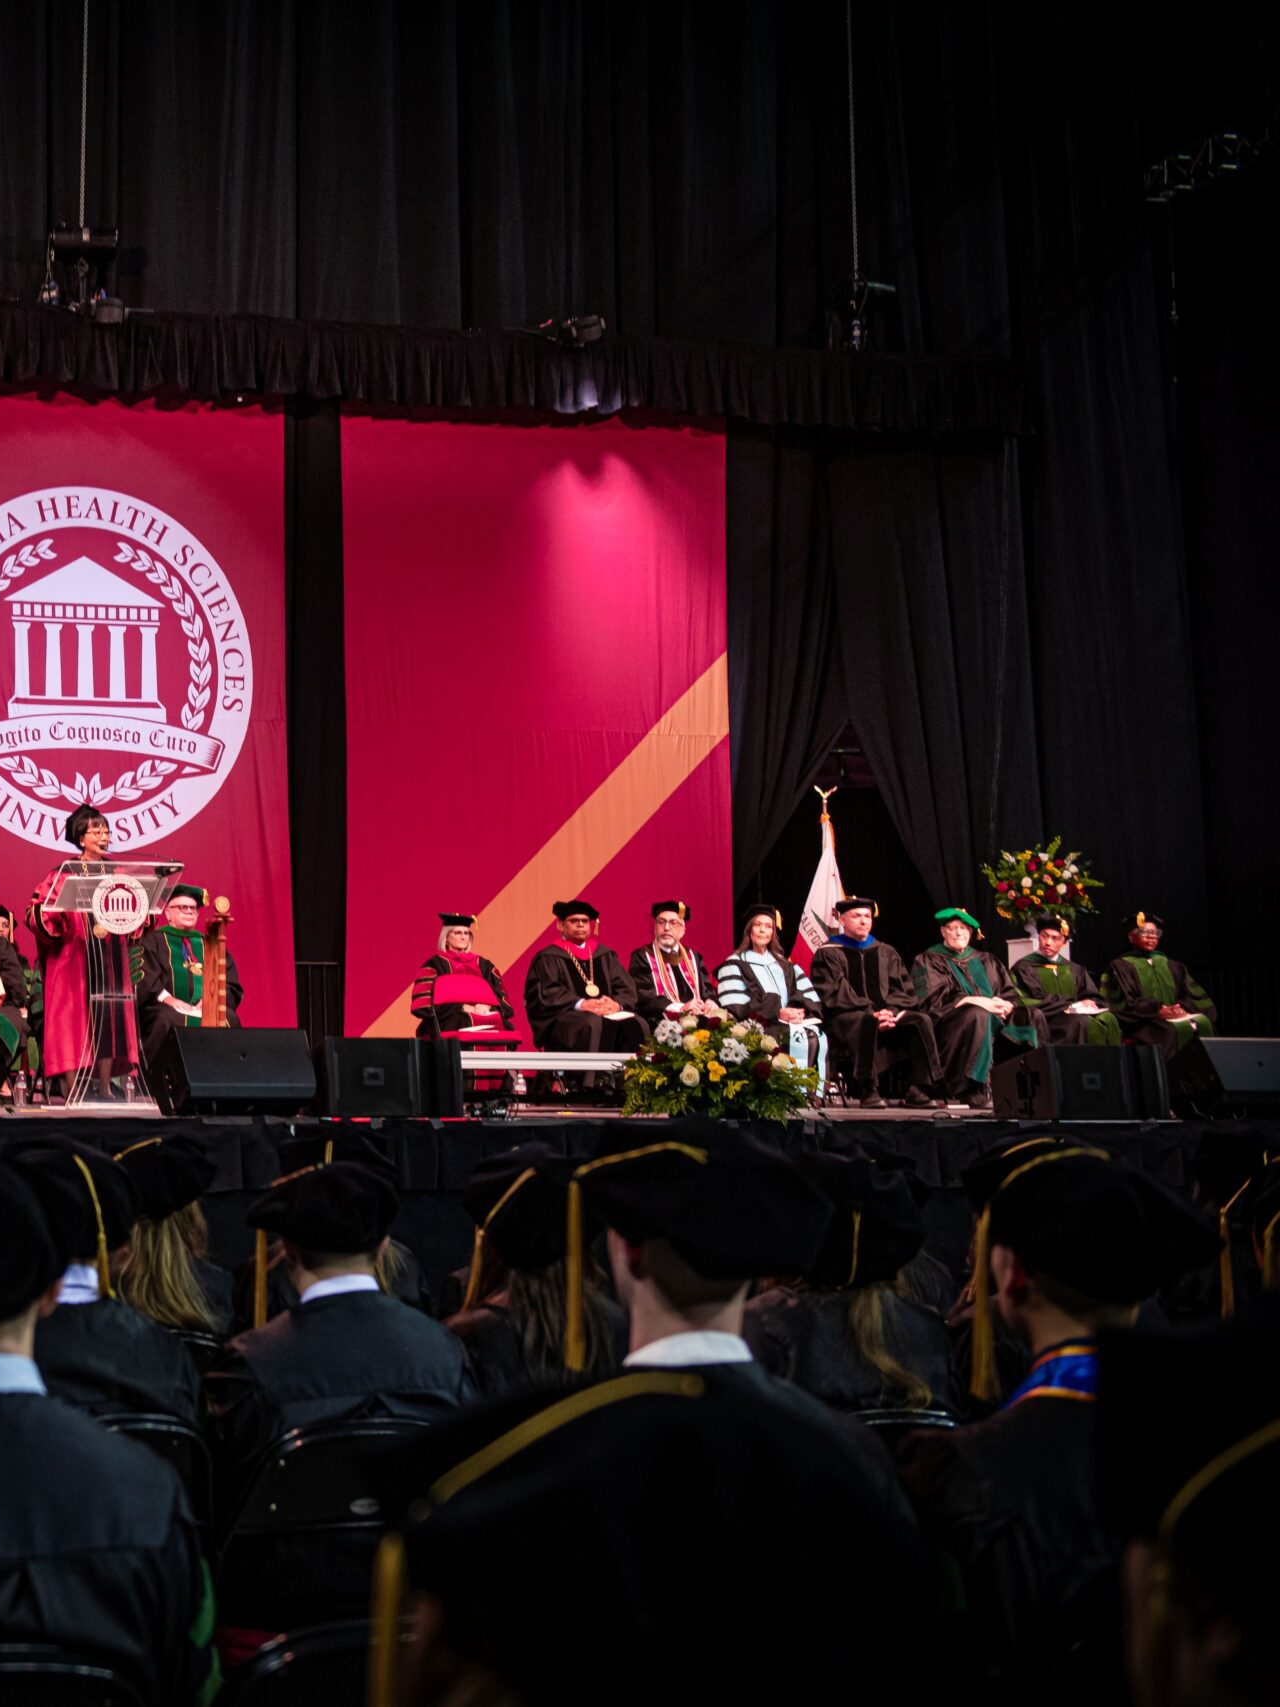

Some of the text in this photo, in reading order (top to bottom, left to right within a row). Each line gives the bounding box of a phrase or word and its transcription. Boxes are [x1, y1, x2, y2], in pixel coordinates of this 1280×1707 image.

[35, 495, 171, 547] HEALTH
[173, 544, 246, 713] SCIENCES
[49, 722, 142, 749] Cognosco
[149, 731, 199, 755] Curo
